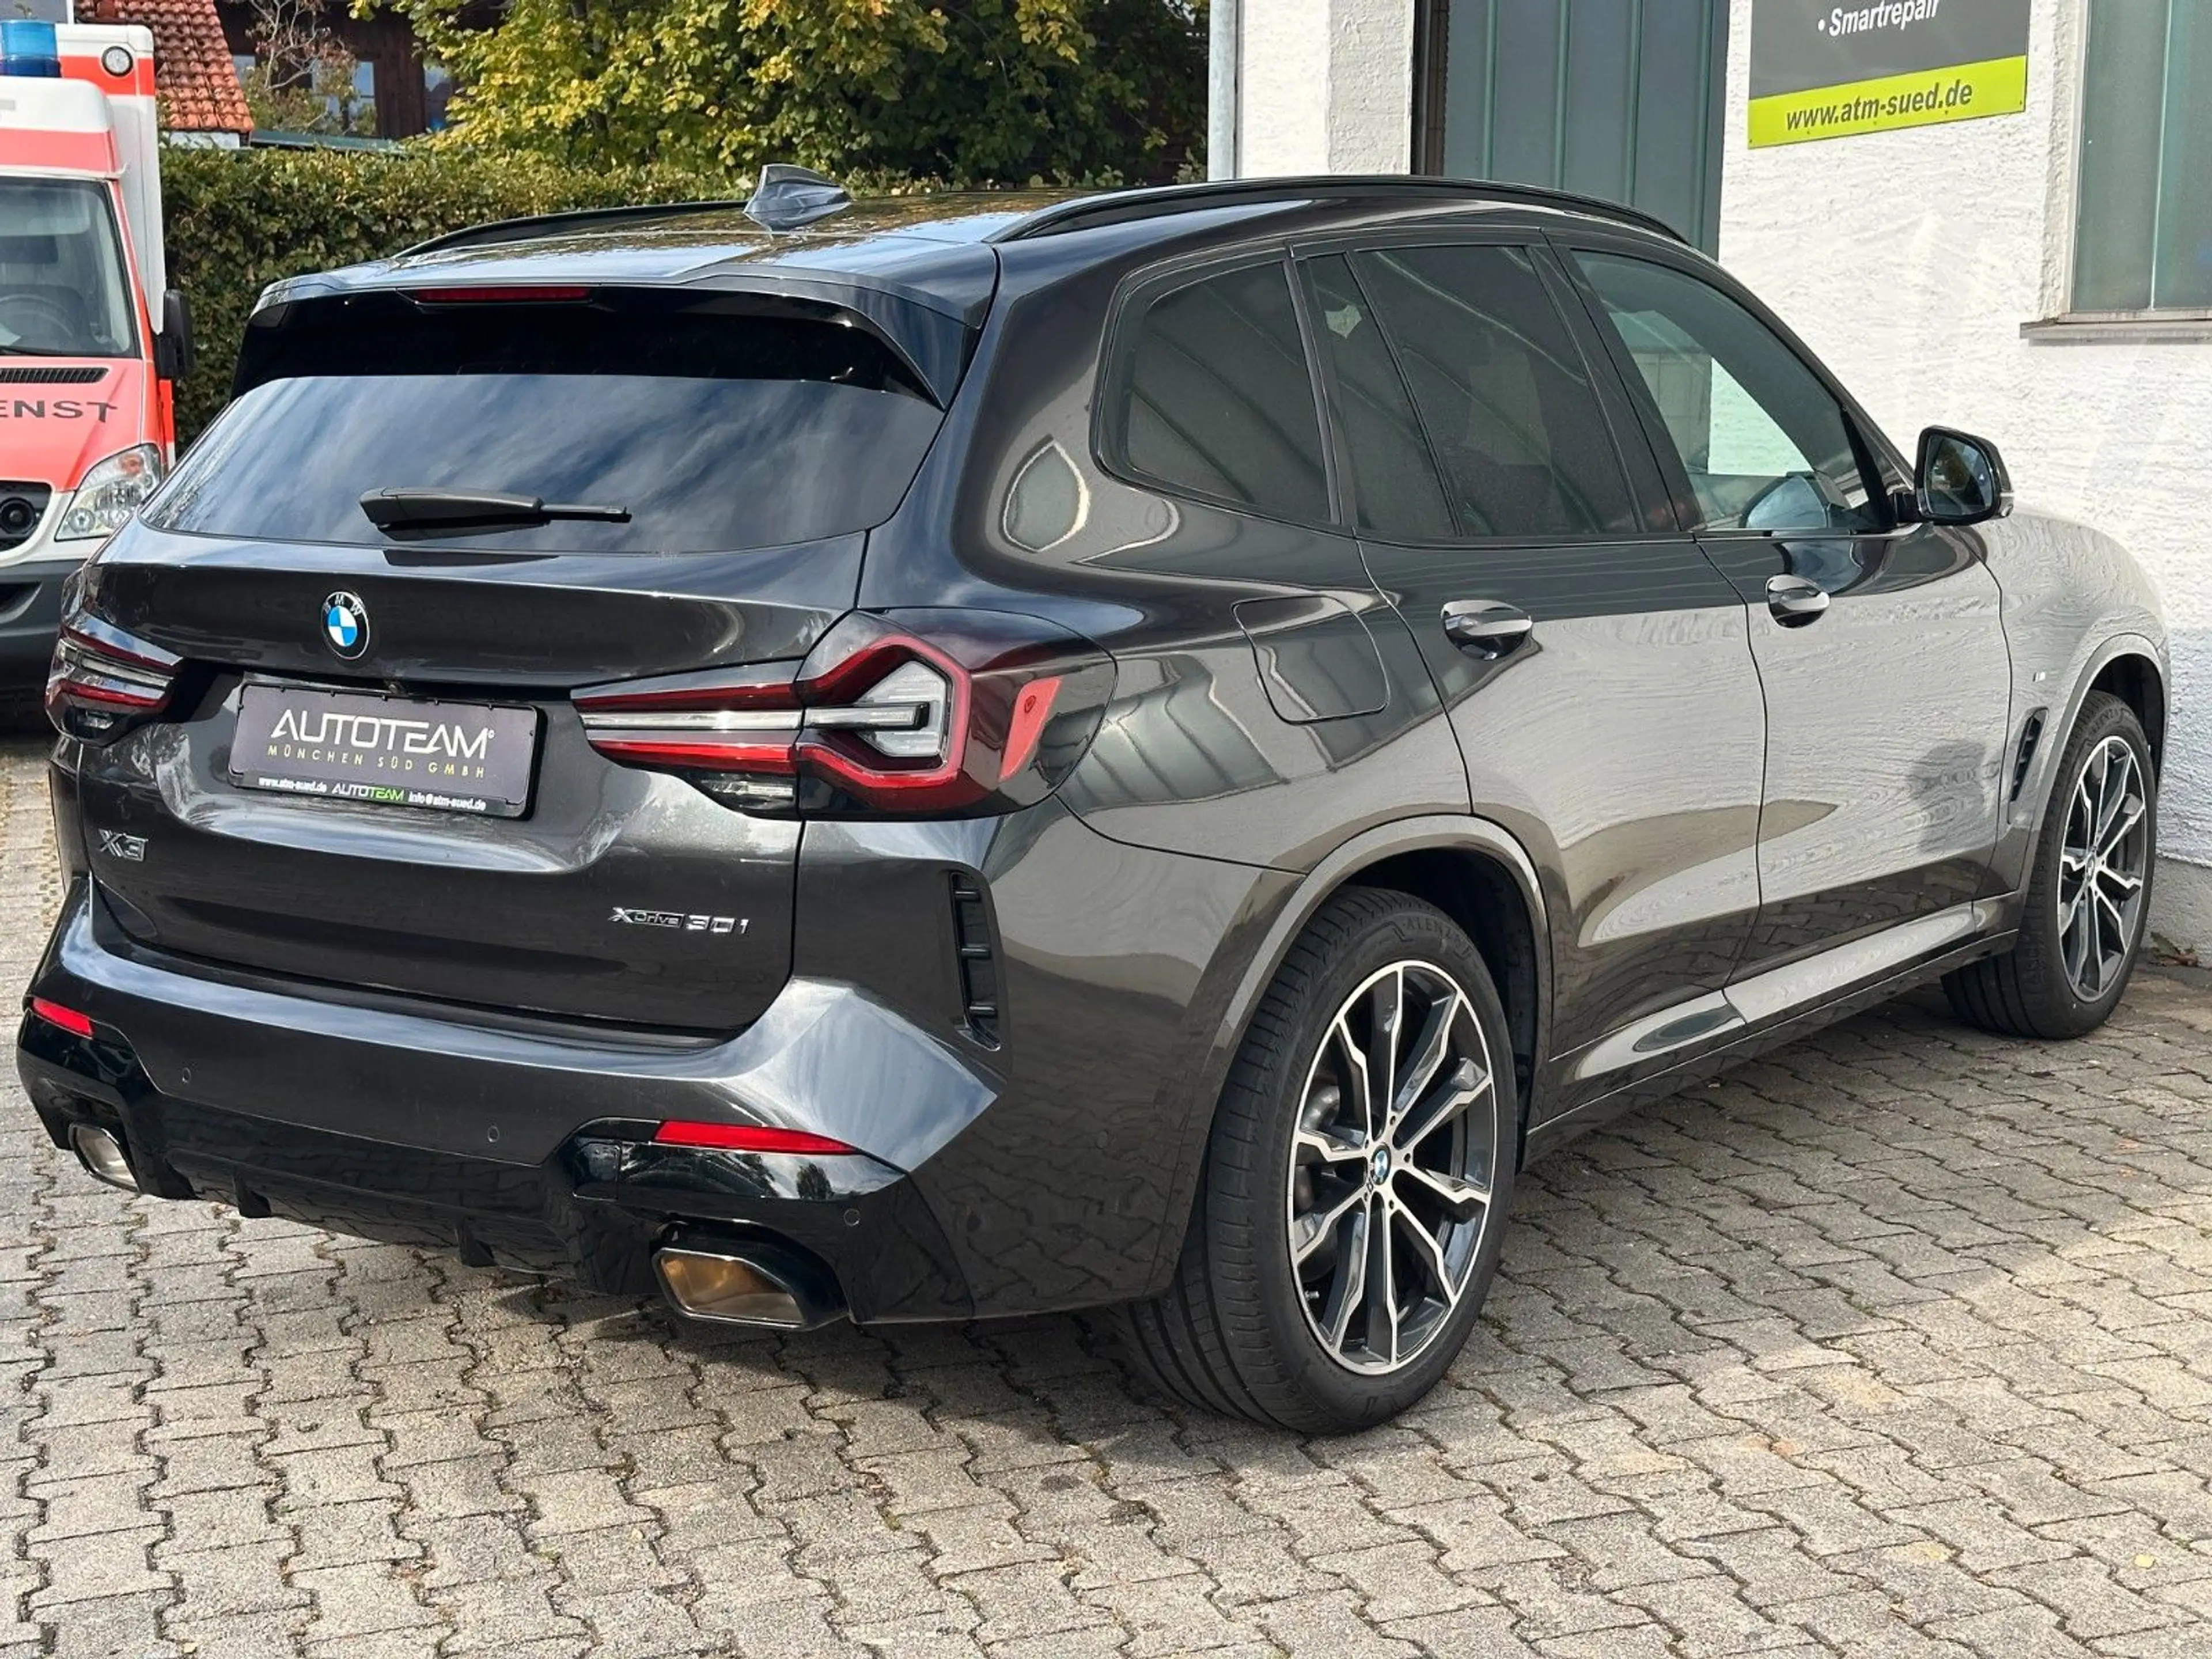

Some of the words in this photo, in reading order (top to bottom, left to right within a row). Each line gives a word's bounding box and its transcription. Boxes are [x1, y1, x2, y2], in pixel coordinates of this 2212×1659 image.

[1828, 0, 1940, 37] Smartrepair
[1786, 79, 1972, 131] www.atm-sued.de
[267, 744, 363, 765] MÜNCHEN
[377, 755, 414, 771] SÜD
[427, 761, 485, 779] GMBH
[332, 783, 404, 801] AUTOTEAM
[98, 828, 149, 862] X3
